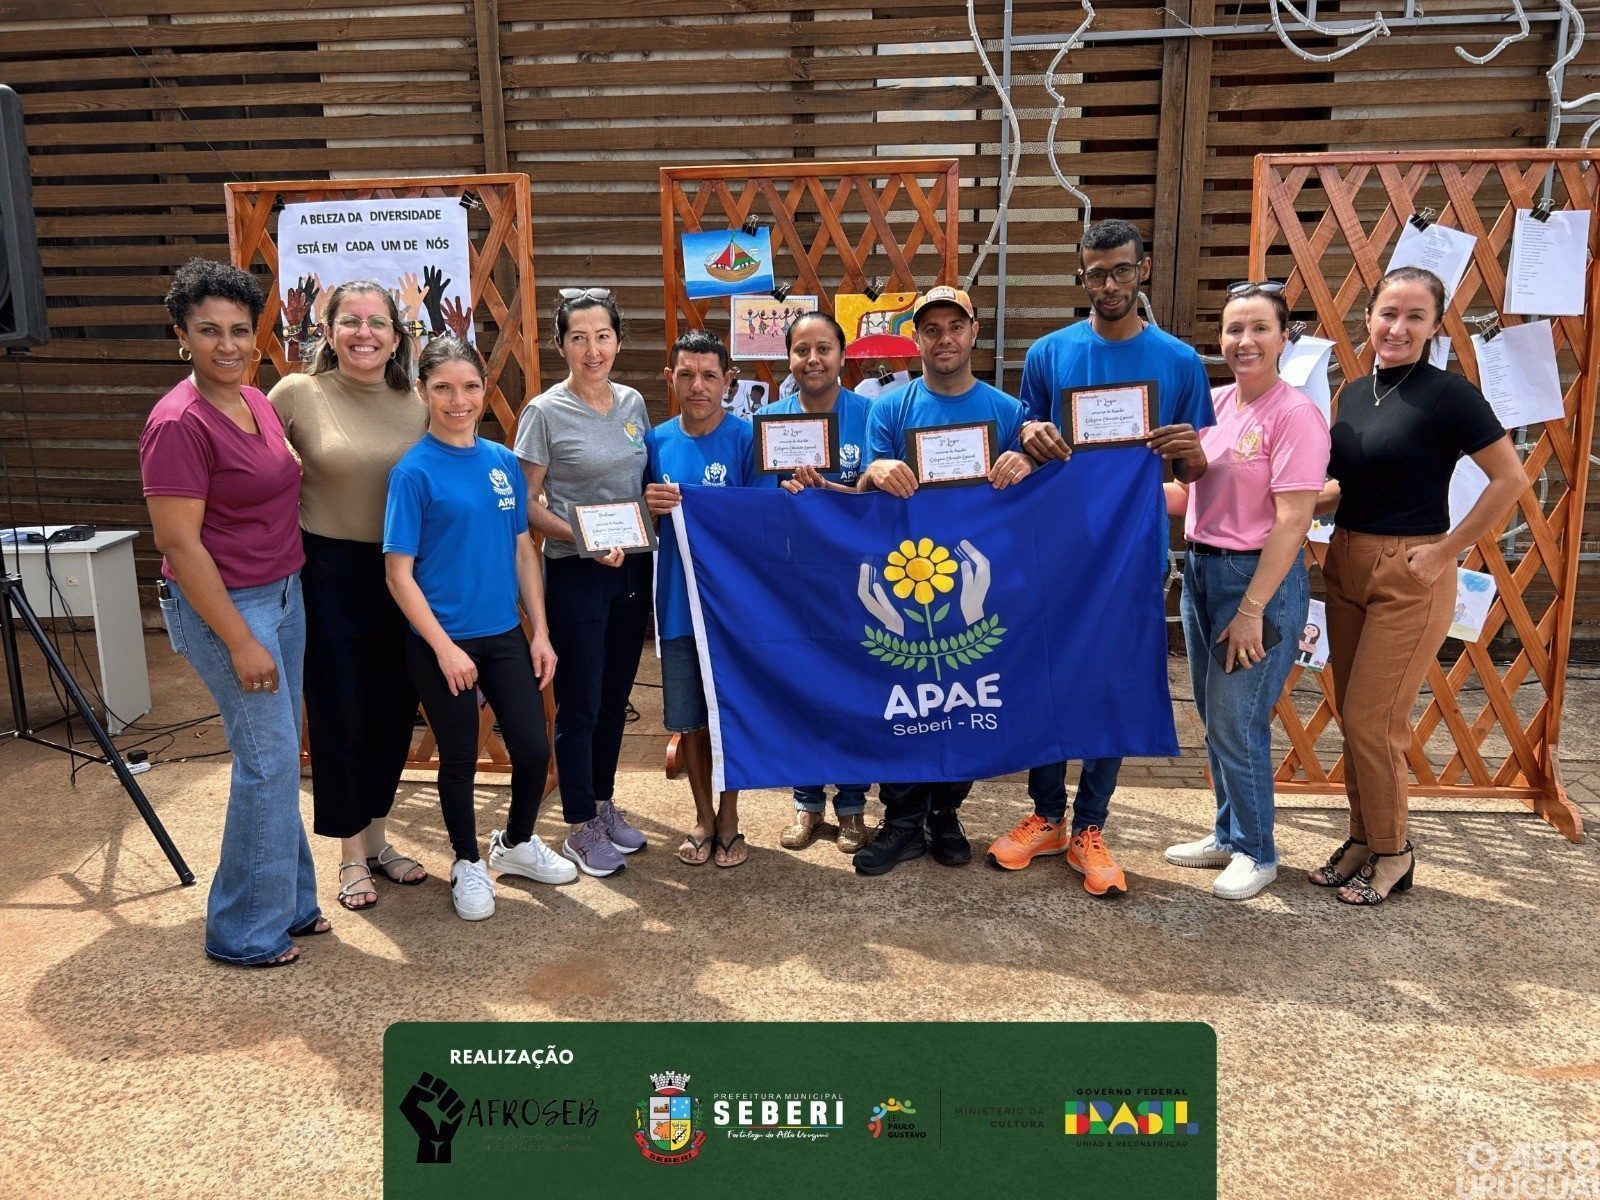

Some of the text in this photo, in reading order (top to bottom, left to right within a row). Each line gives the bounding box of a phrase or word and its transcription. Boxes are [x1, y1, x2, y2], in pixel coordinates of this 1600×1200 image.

[300, 209, 442, 226] A BELEZA DA DIVERSIDADE
[297, 236, 449, 254] ESTÁ EM CADA UM DE NÓS
[883, 673, 1003, 720] APAE
[893, 716, 952, 736] Seberi
[970, 713, 998, 730] RS
